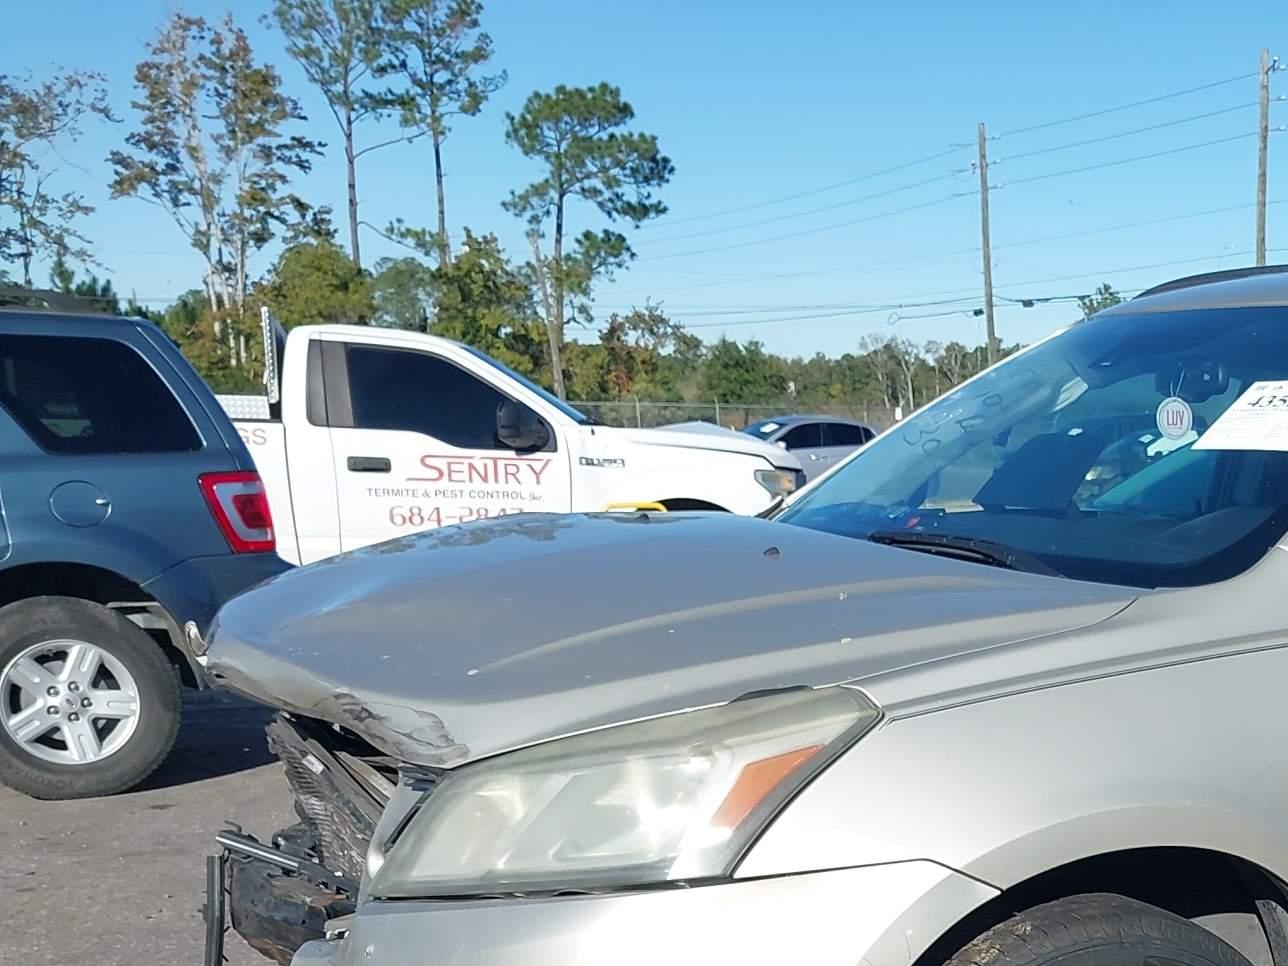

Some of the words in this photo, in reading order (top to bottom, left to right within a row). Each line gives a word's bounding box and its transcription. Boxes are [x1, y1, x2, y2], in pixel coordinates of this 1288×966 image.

[405, 454, 553, 485] SENTRY
[366, 487, 418, 498] TERMITE
[421, 488, 431, 498] &
[434, 489, 465, 499] PEST
[468, 490, 526, 500] CONTROL
[388, 505, 525, 528] 684-28
